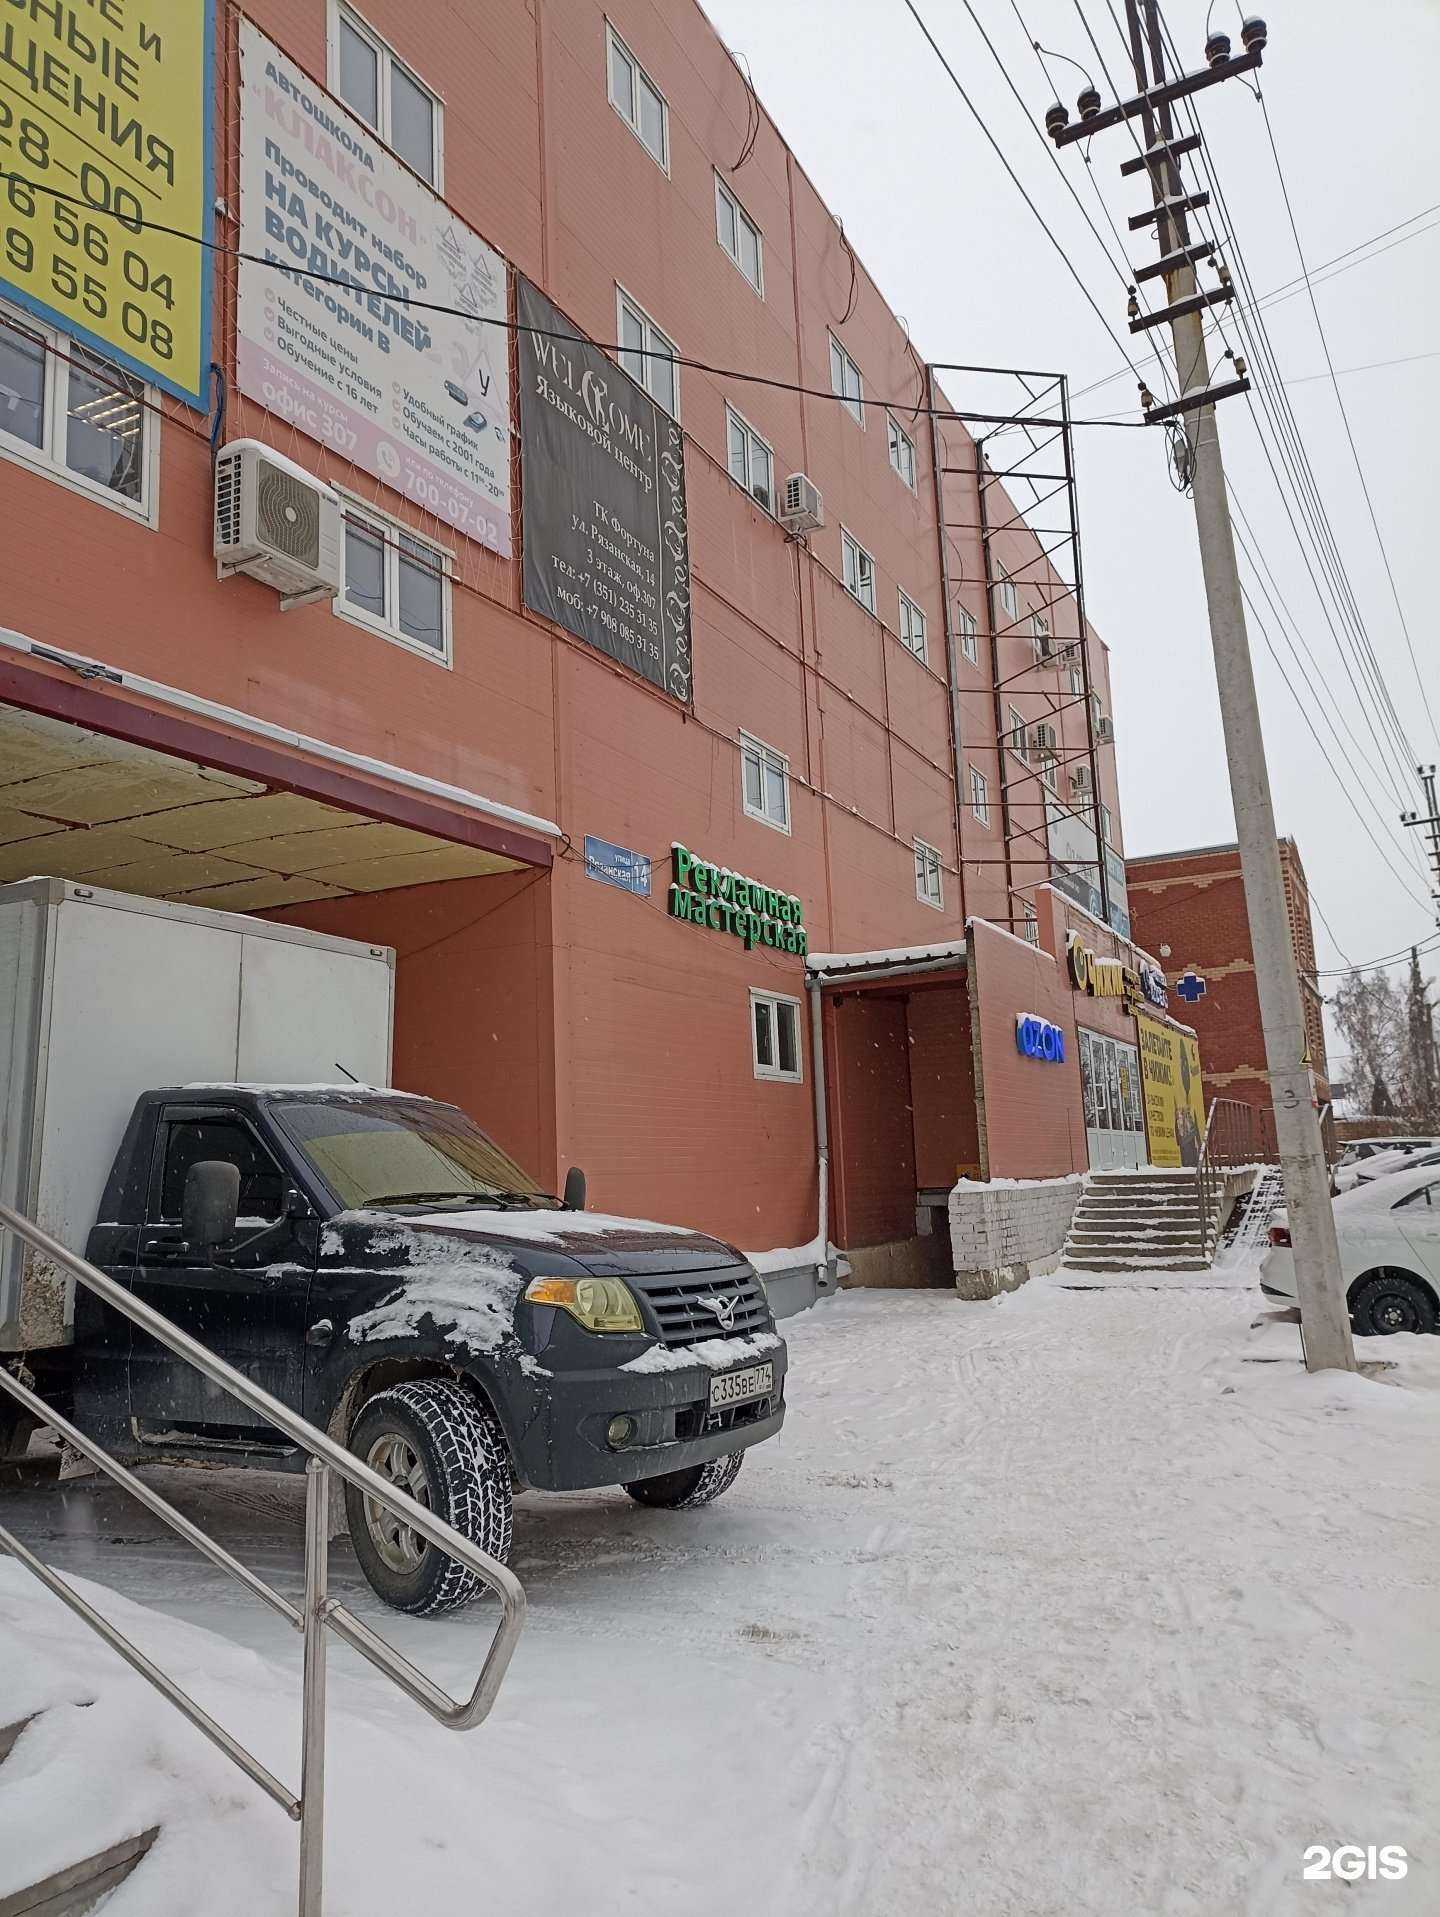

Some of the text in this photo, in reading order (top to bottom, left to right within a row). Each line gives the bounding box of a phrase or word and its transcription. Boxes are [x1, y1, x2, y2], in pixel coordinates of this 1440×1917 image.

[1, 0, 140, 102] НЫЕ
[265, 61, 375, 173] АВТОШКОЛА
[53, 199, 109, 267] 56
[123, 249, 175, 311] 04
[265, 170, 410, 311] НА КУРСЫ
[371, 233, 427, 290] набор
[6, 227, 173, 360] 9 55 08
[265, 206, 431, 352] ВОДИТЕЛЕЙ
[278, 296, 358, 364] Честные цены
[278, 315, 382, 399] Выгодные условия
[277, 336, 335, 384] Обучение
[346, 384, 357, 399] 16
[360, 396, 379, 414] лет
[262, 382, 358, 450] офис 307
[402, 406, 444, 443] Обучаем
[452, 441, 473, 464] 2001
[475, 459, 495, 478] года
[403, 388, 479, 451] Удобный график
[535, 375, 652, 493] Языковой центр
[428, 445, 462, 472] работы
[404, 467, 497, 542] 700-07-02
[593, 500, 655, 562] ТК Фортуна
[571, 514, 655, 587] ул. Рязанская, 14
[587, 548, 593, 564] 3
[596, 557, 625, 589] этаж,
[578, 572, 590, 587] +7
[593, 579, 617, 607] (351)
[619, 597, 634, 618] 235
[636, 610, 647, 627] 31
[648, 618, 657, 635] 35
[586, 604, 599, 619] +7
[601, 610, 617, 633] 908
[619, 623, 635, 644] 085
[636, 635, 647, 652] 31
[649, 642, 659, 660] 35
[633, 861, 648, 887] 14
[673, 846, 804, 925] Рекламная
[1018, 1015, 1065, 1064] OZON
